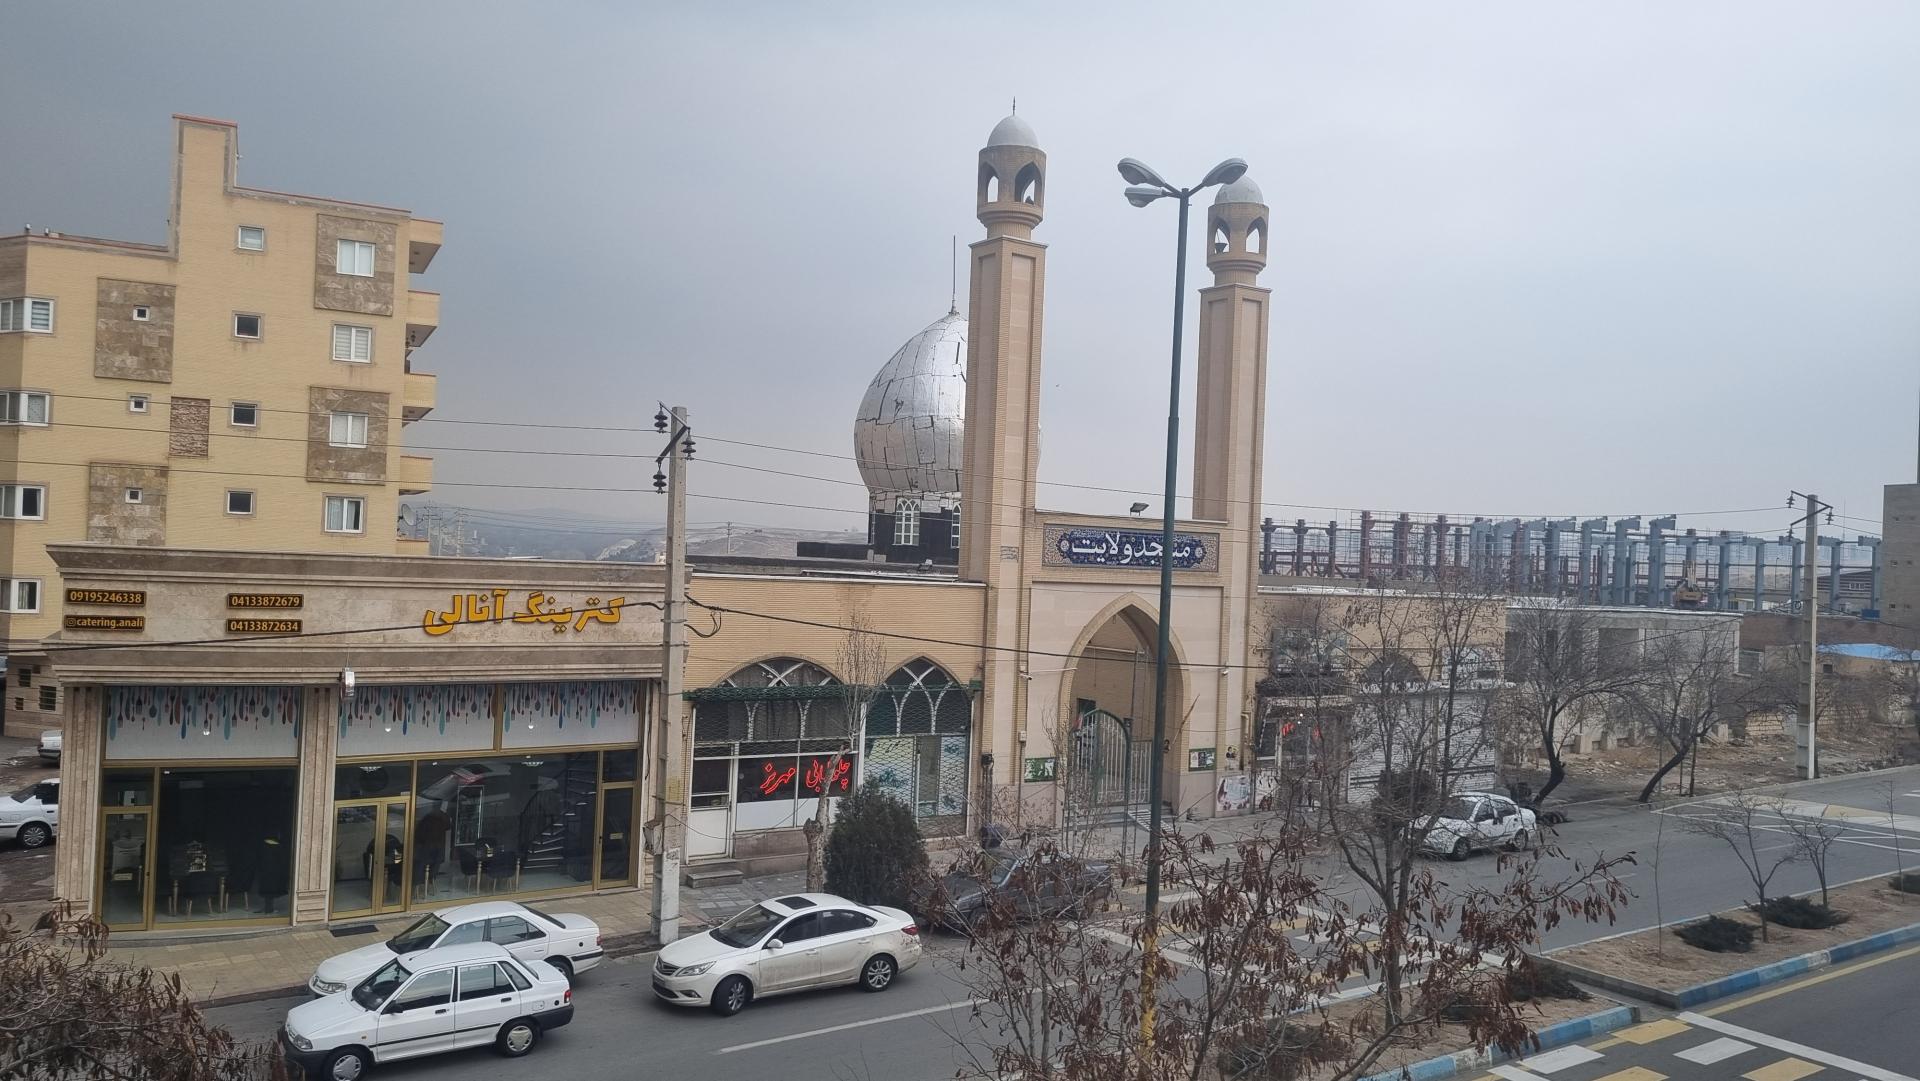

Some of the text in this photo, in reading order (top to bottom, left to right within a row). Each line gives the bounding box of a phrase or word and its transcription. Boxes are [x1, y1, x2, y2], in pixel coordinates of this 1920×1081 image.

[1071, 532, 1132, 564] ولایت
[70, 591, 142, 603] 09195246338
[231, 596, 300, 607] 04133872679
[423, 588, 625, 635] کترینگ آنالی
[76, 617, 143, 629] catering.anali
[230, 621, 299, 631] 04133872634
